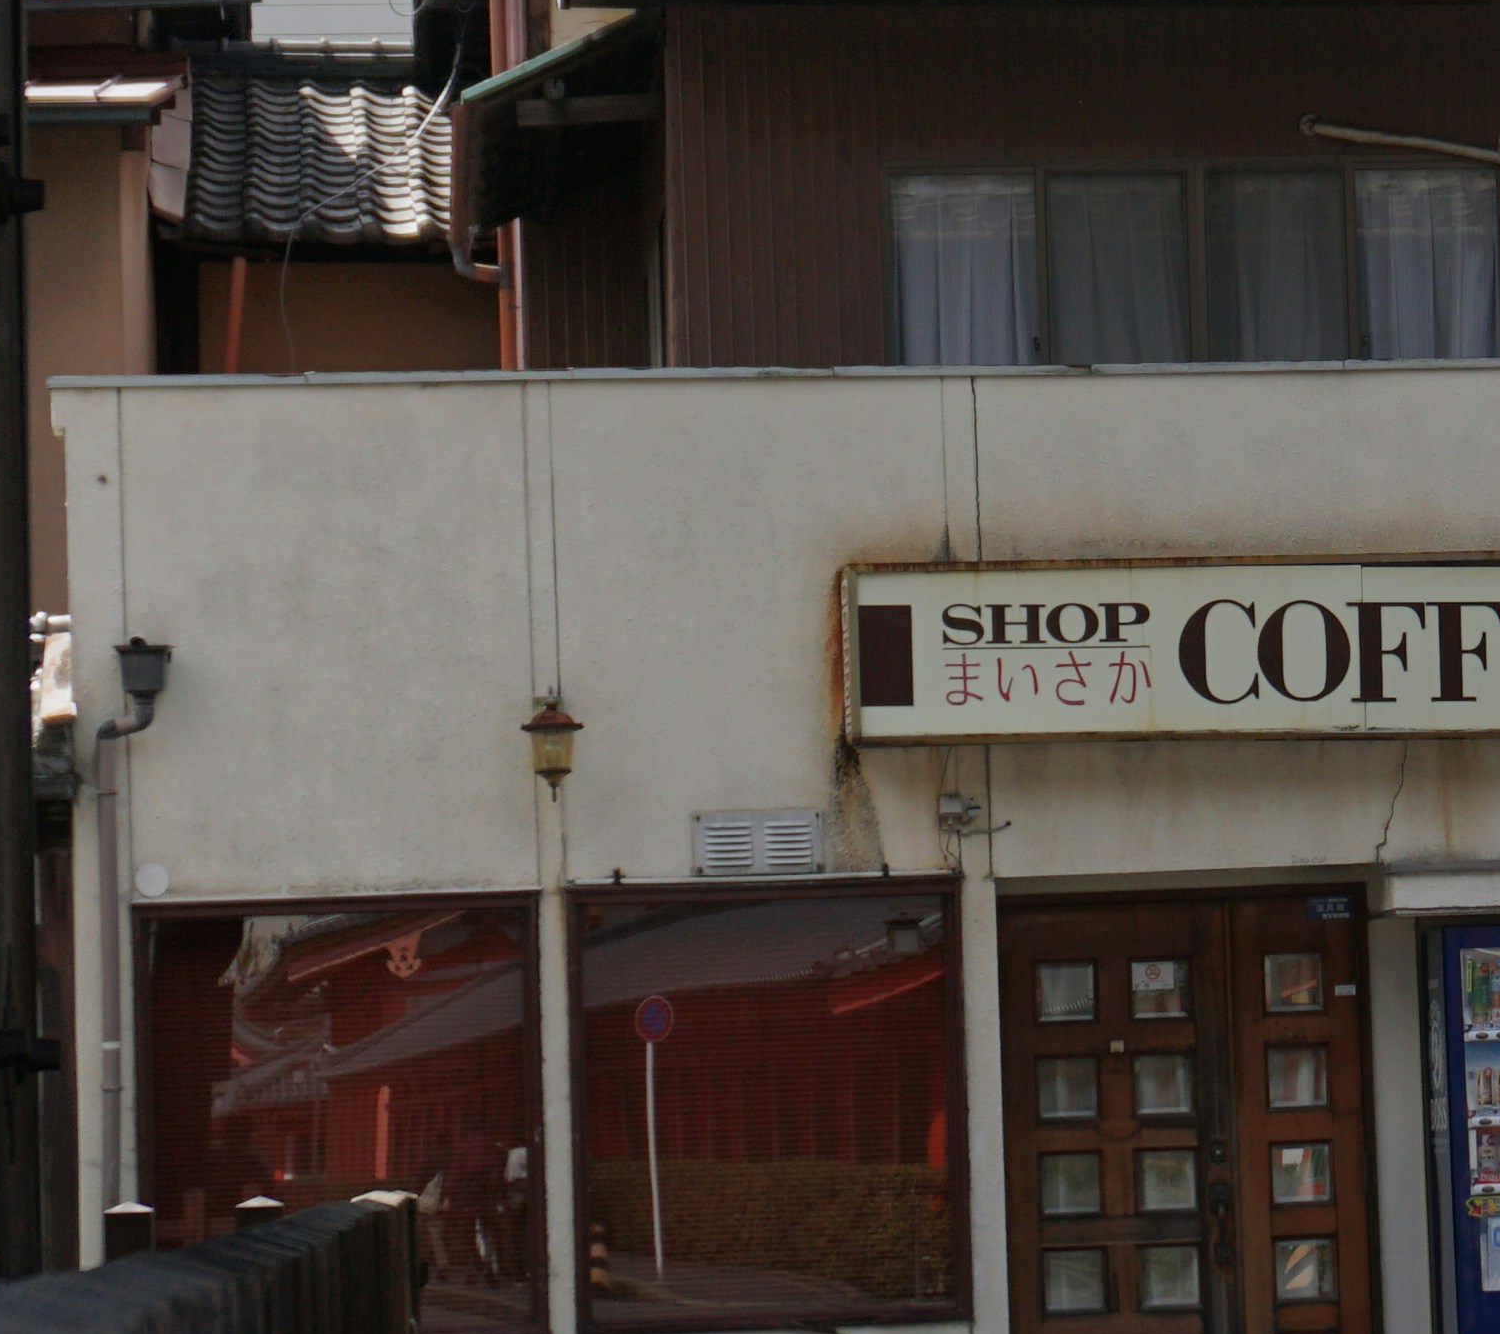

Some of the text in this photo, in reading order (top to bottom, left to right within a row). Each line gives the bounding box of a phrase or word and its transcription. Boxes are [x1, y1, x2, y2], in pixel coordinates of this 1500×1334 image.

[941, 601, 1151, 646] SHOP
[943, 650, 1153, 706] まいさか
